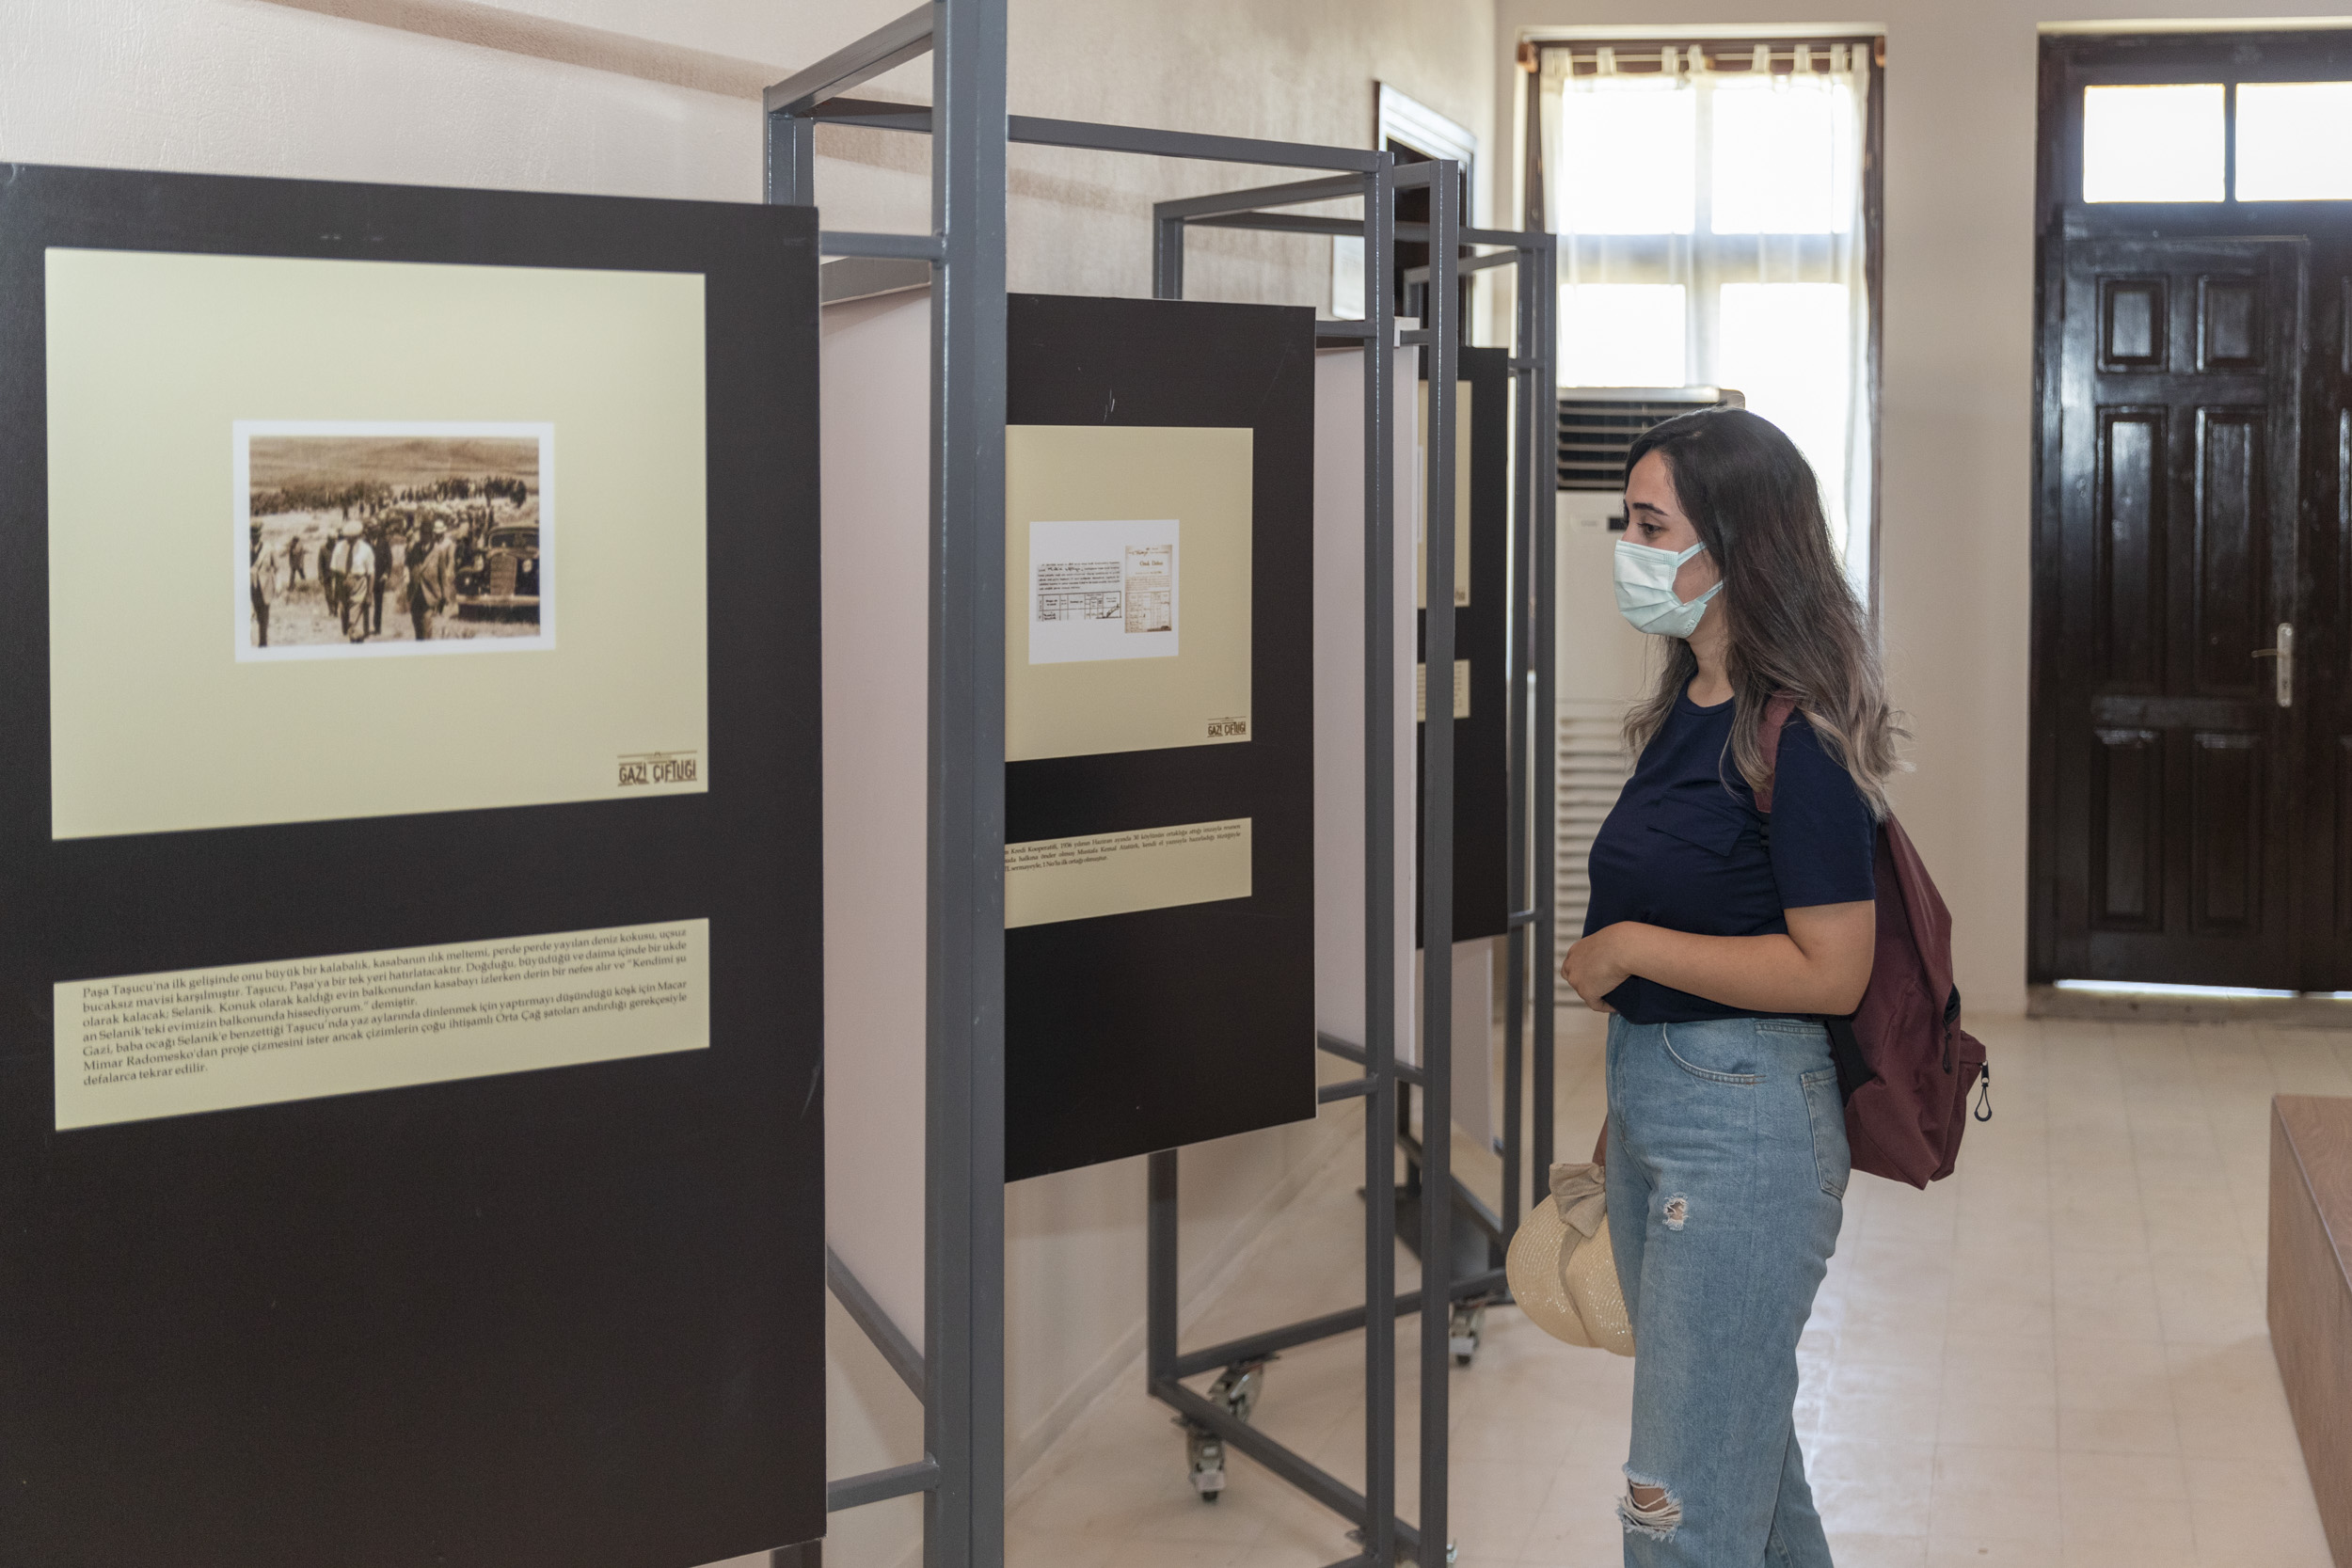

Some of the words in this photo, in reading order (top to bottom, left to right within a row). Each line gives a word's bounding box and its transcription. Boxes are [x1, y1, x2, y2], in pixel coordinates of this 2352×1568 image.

[83, 988, 109, 998] Paşa
[172, 978, 186, 989] ilk
[189, 973, 239, 990] gelişinde
[241, 973, 262, 981] onu
[265, 966, 300, 979] büyük
[302, 965, 317, 975] bir
[320, 959, 370, 974] kalabalık,
[373, 956, 425, 968] kasabanın
[428, 952, 444, 962] ılık
[446, 948, 489, 959] meltemi,
[493, 944, 521, 958] perde
[523, 942, 551, 955] perde
[553, 938, 589, 951] yayılan
[591, 935, 617, 945] deniz
[620, 932, 657, 942] kokusu,
[660, 929, 686, 940] uçsuz
[83, 1000, 133, 1012] bucaksız
[135, 994, 173, 1006] mavisi
[176, 989, 243, 1003] karşılmıştır.
[246, 985, 287, 996] Taşucu,
[331, 976, 346, 986] bir
[348, 974, 364, 984] tek
[367, 972, 387, 985] yeri
[389, 965, 464, 980] hatırlatacaktır.
[466, 959, 516, 973] Doğduğu,
[518, 954, 570, 967] büyüdüğü
[585, 950, 615, 959] daima
[617, 944, 646, 958] içinde
[648, 943, 660, 953] bir
[662, 941, 686, 951] ukde
[83, 1014, 119, 1027] olarak
[122, 1009, 167, 1022] kalacak;
[171, 1004, 215, 1017] Selanik.
[219, 1000, 256, 1012] Konuk
[259, 995, 293, 1007] olarak
[296, 992, 333, 1004] kaldığı
[336, 990, 358, 1000] evin
[362, 982, 431, 996] balkonundan
[434, 977, 478, 989] kasabayı
[481, 972, 520, 984] izlerken
[523, 969, 549, 979] derin
[552, 967, 565, 976] bir
[568, 964, 593, 974] nefes
[596, 962, 611, 972] alır
[675, 956, 686, 964] şu
[83, 1044, 113, 1056] Gazi,
[116, 1041, 143, 1053] baba
[145, 1038, 175, 1050] ocağı
[230, 1025, 283, 1039] benzettiği
[351, 1017, 368, 1027] yaz
[371, 1009, 421, 1024] aylarında
[422, 1003, 477, 1018] dinlenmek
[480, 1002, 497, 1012] için
[500, 997, 553, 1010] yaptırmayı
[556, 989, 612, 1003] düşündüğü
[614, 985, 636, 996] köşk
[639, 984, 655, 994] için
[658, 981, 686, 990] Macar
[83, 1034, 97, 1042] an
[167, 1019, 216, 1033] evimizin
[219, 1010, 284, 1026] balkonunda
[371, 997, 417, 1009] demiştir.
[84, 1060, 122, 1070] Mimar
[221, 1044, 248, 1057] proje
[251, 1037, 303, 1053] çizmesini
[307, 1036, 329, 1045] ister
[332, 1029, 362, 1042] ancak
[366, 1024, 418, 1039] çizimlerin
[421, 1022, 445, 1033] çoğu
[450, 1015, 493, 1028] ihtişamlı
[496, 1013, 518, 1022] Orta
[521, 1009, 541, 1021] Çağ
[543, 1006, 579, 1019] şatoları
[582, 1001, 627, 1013] andırdığı
[629, 992, 687, 1009] gerekçesiyle
[83, 1072, 136, 1085] defalarca
[138, 1068, 172, 1079] tekrar
[174, 1063, 207, 1074] edilir.
